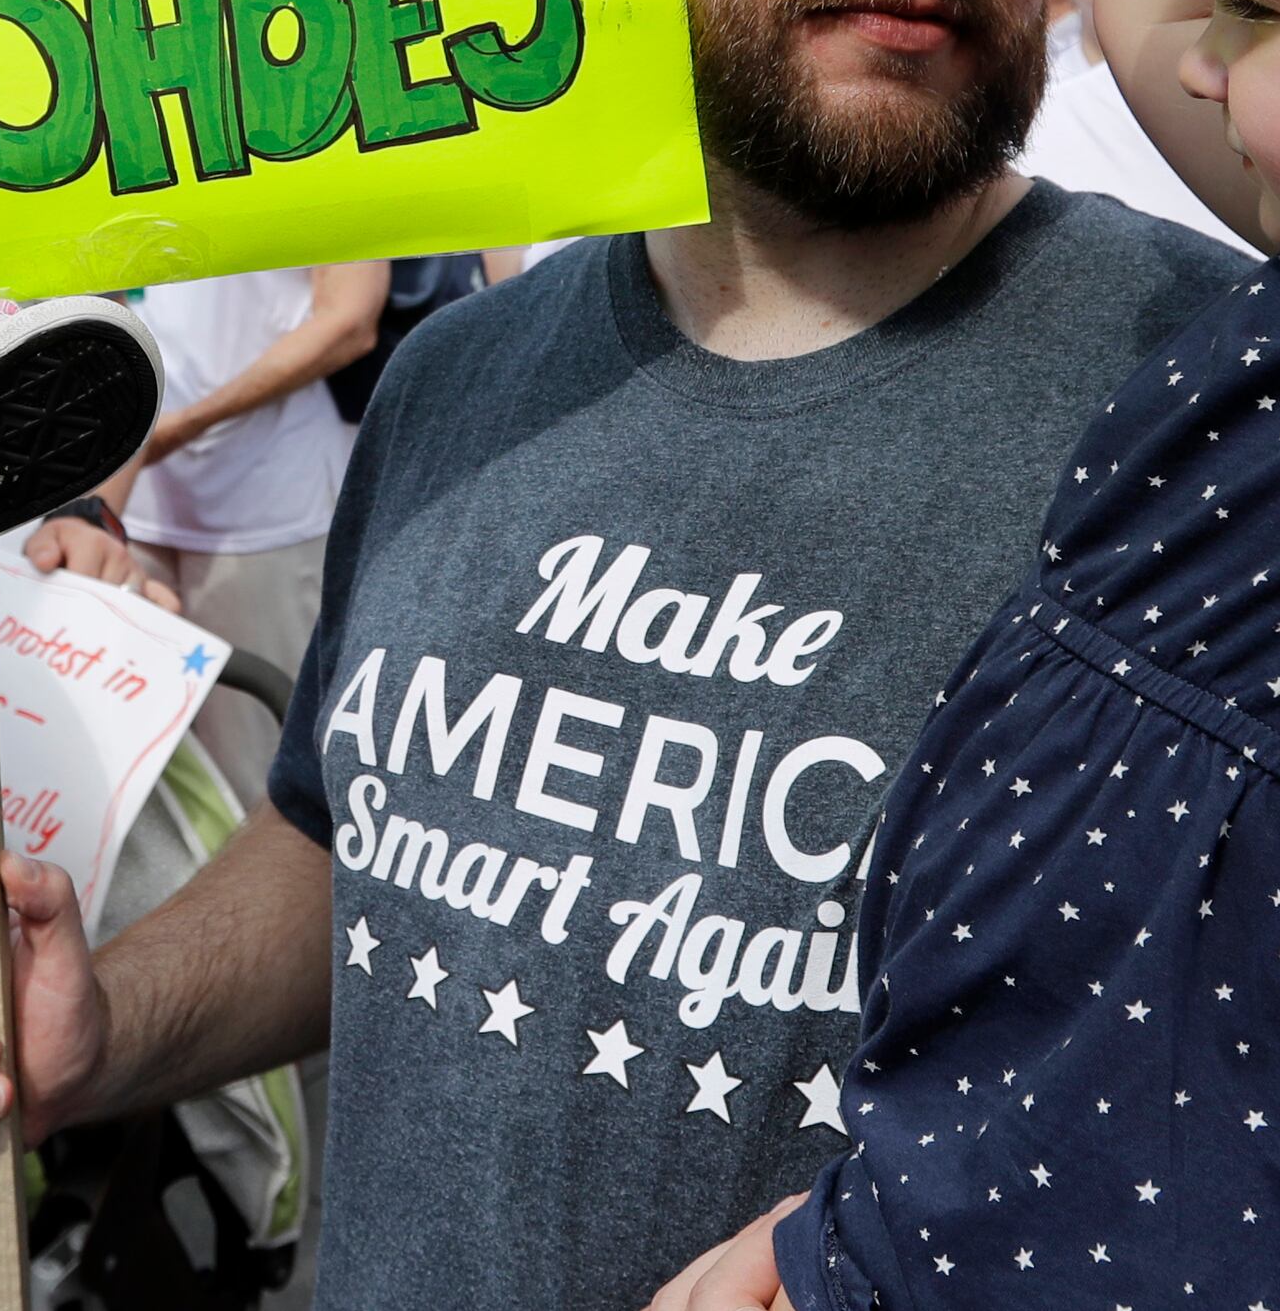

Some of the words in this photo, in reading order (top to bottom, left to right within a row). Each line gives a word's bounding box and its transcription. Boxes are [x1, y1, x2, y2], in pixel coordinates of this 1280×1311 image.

[102, 658, 149, 702] in
[515, 534, 844, 687] Make
[322, 647, 885, 892] AMERIC
[335, 774, 594, 945] Smart
[605, 873, 862, 1029] Agai
